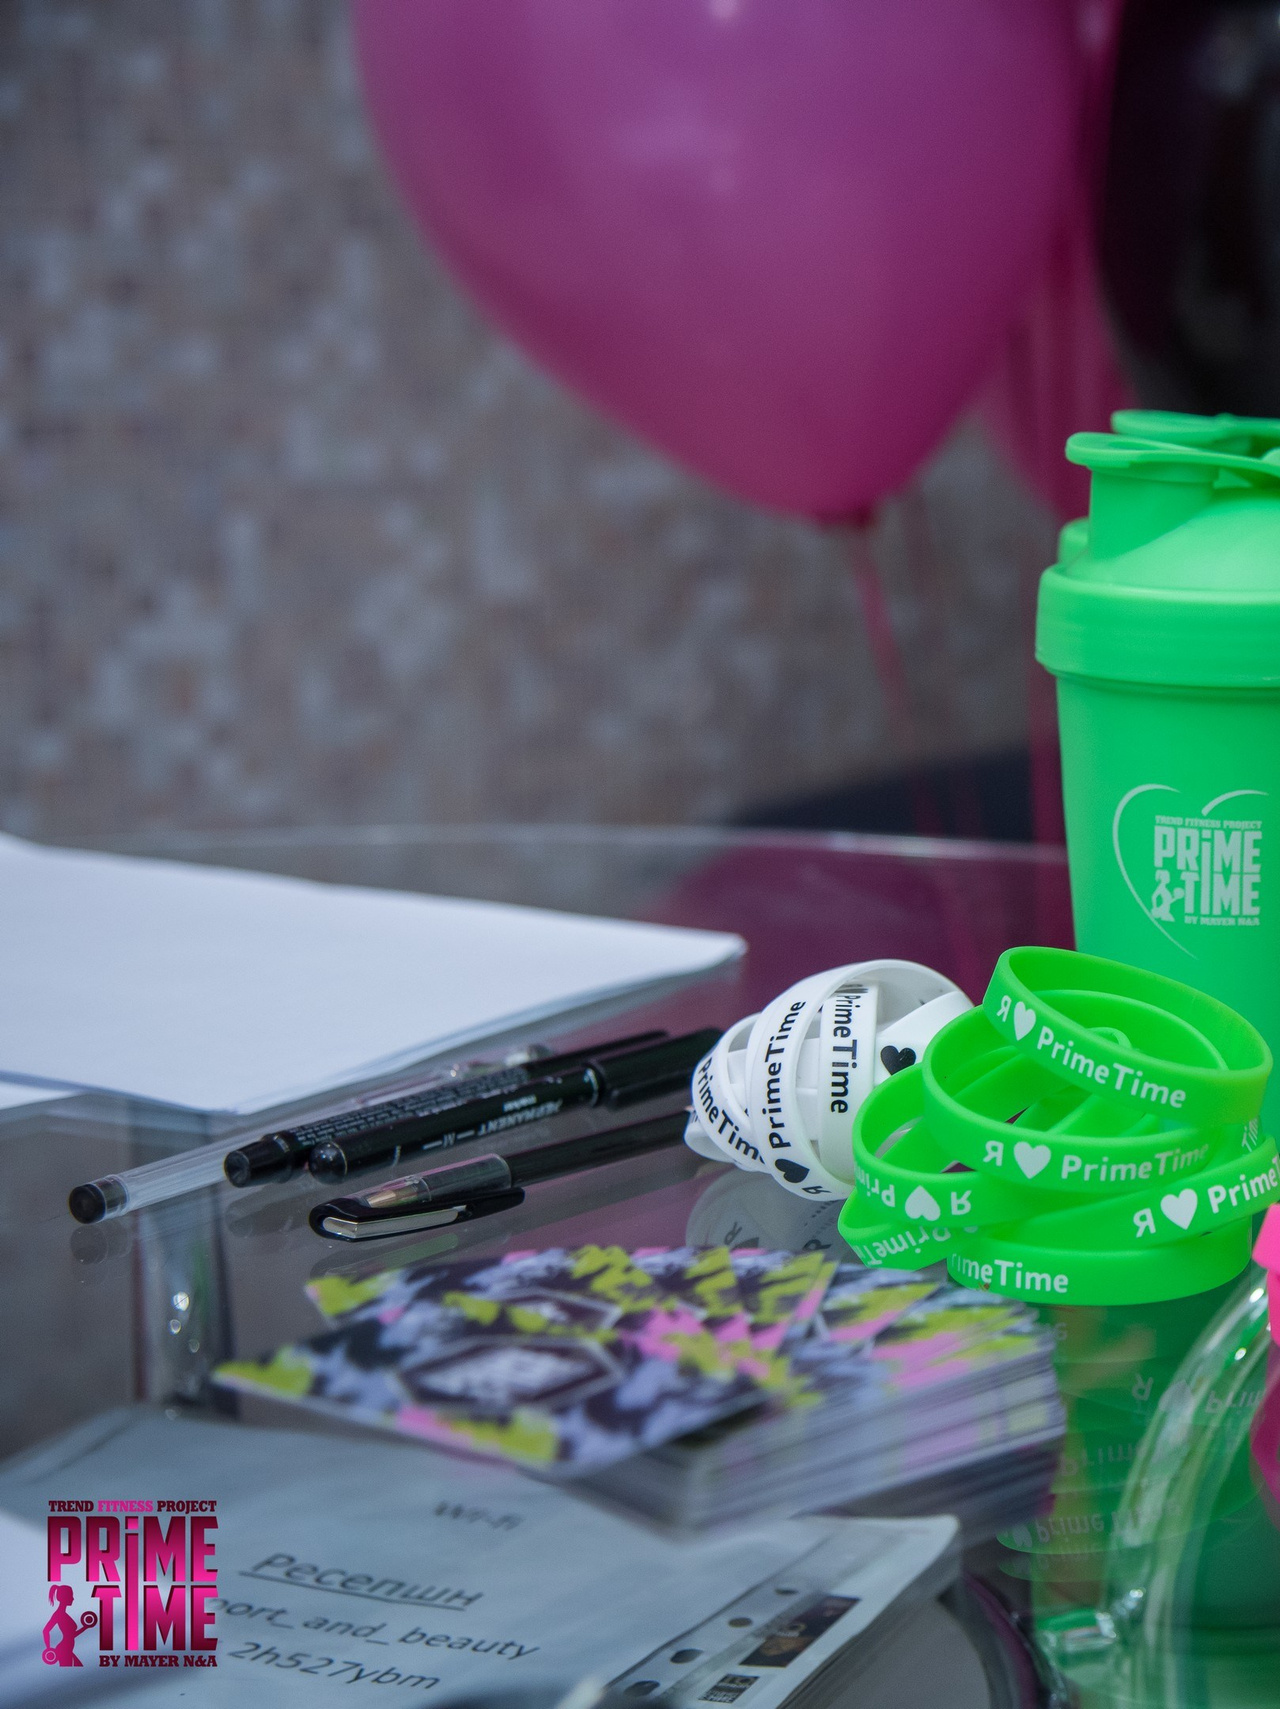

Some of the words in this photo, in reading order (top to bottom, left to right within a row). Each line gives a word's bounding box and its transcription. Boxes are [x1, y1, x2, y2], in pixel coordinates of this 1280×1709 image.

[762, 1001, 806, 1149] PrimeTime
[1036, 1025, 1187, 1109] PrimeTime
[982, 1139, 1004, 1167] Я
[1133, 1208, 1156, 1239] Я
